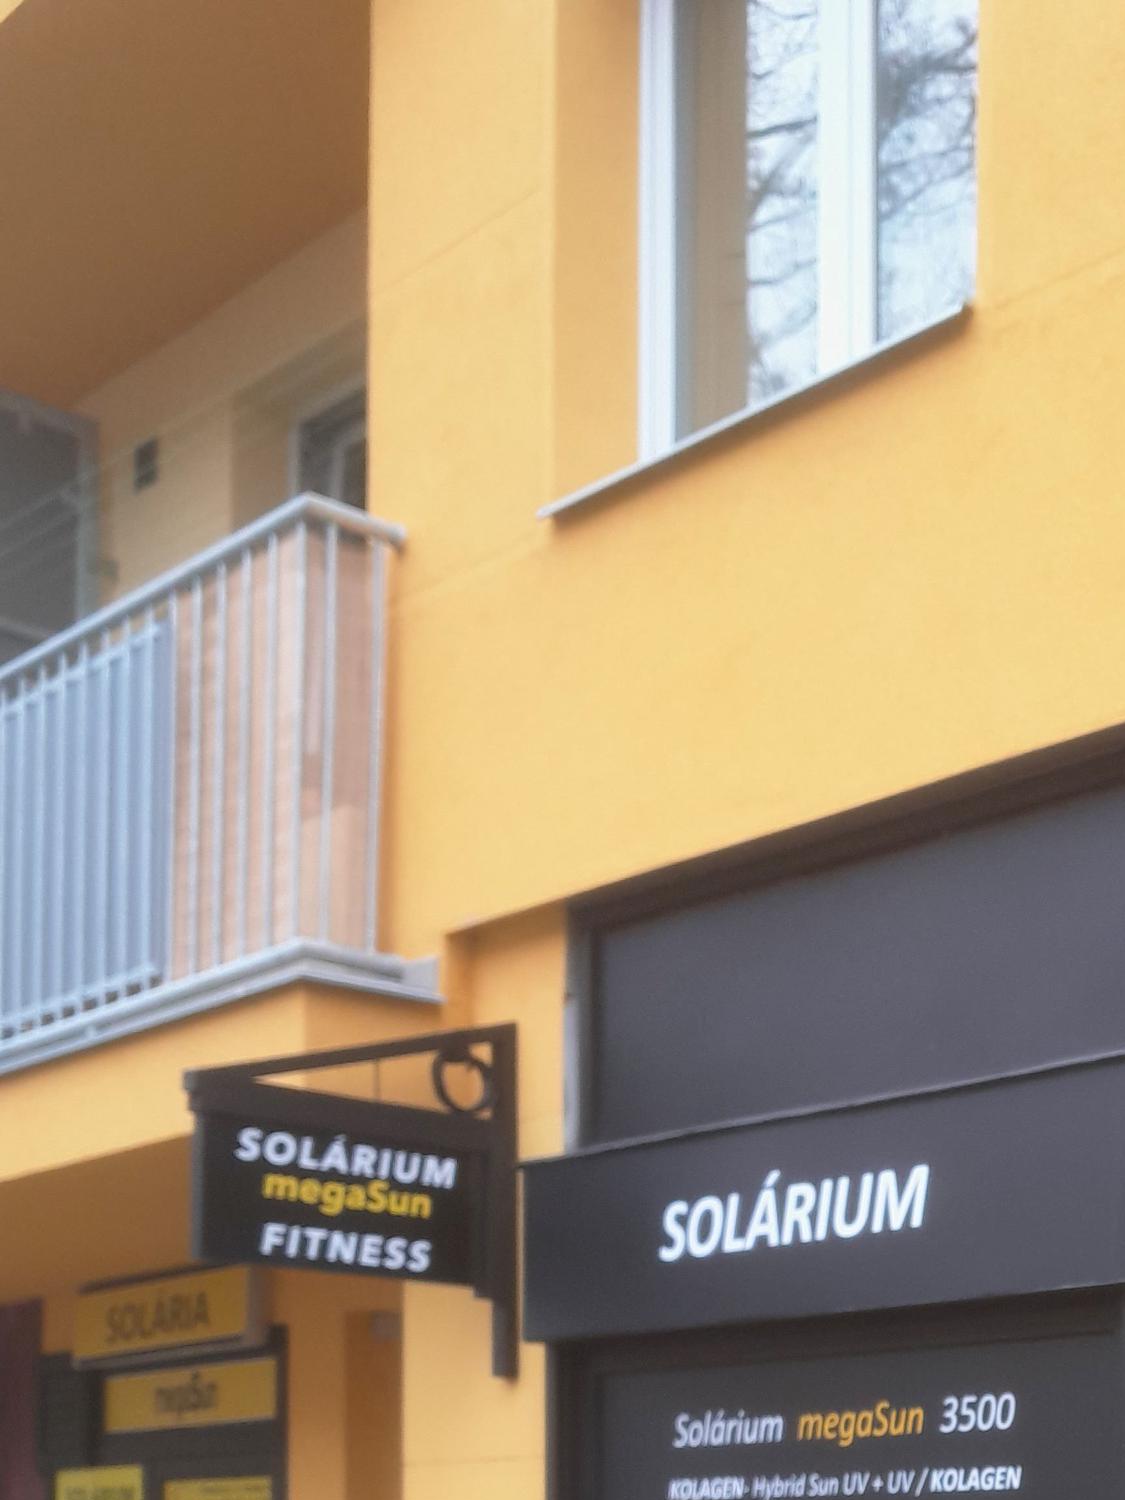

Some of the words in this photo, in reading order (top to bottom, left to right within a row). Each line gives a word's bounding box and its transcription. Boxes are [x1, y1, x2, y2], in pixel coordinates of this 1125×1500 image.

[233, 1126, 458, 1189] SOLÁRIUM
[262, 1172, 433, 1219] megaSun
[659, 1164, 929, 1263] SOLÁRIUM
[259, 1222, 432, 1273] FITNESS
[672, 1408, 784, 1448] Solárium
[797, 1400, 924, 1447] megaSun
[939, 1391, 1016, 1434] 3500
[807, 1472, 839, 1497] Sun
[842, 1471, 870, 1496] UV
[886, 1469, 915, 1494] UV
[930, 1465, 1022, 1493] KOLAGEN
